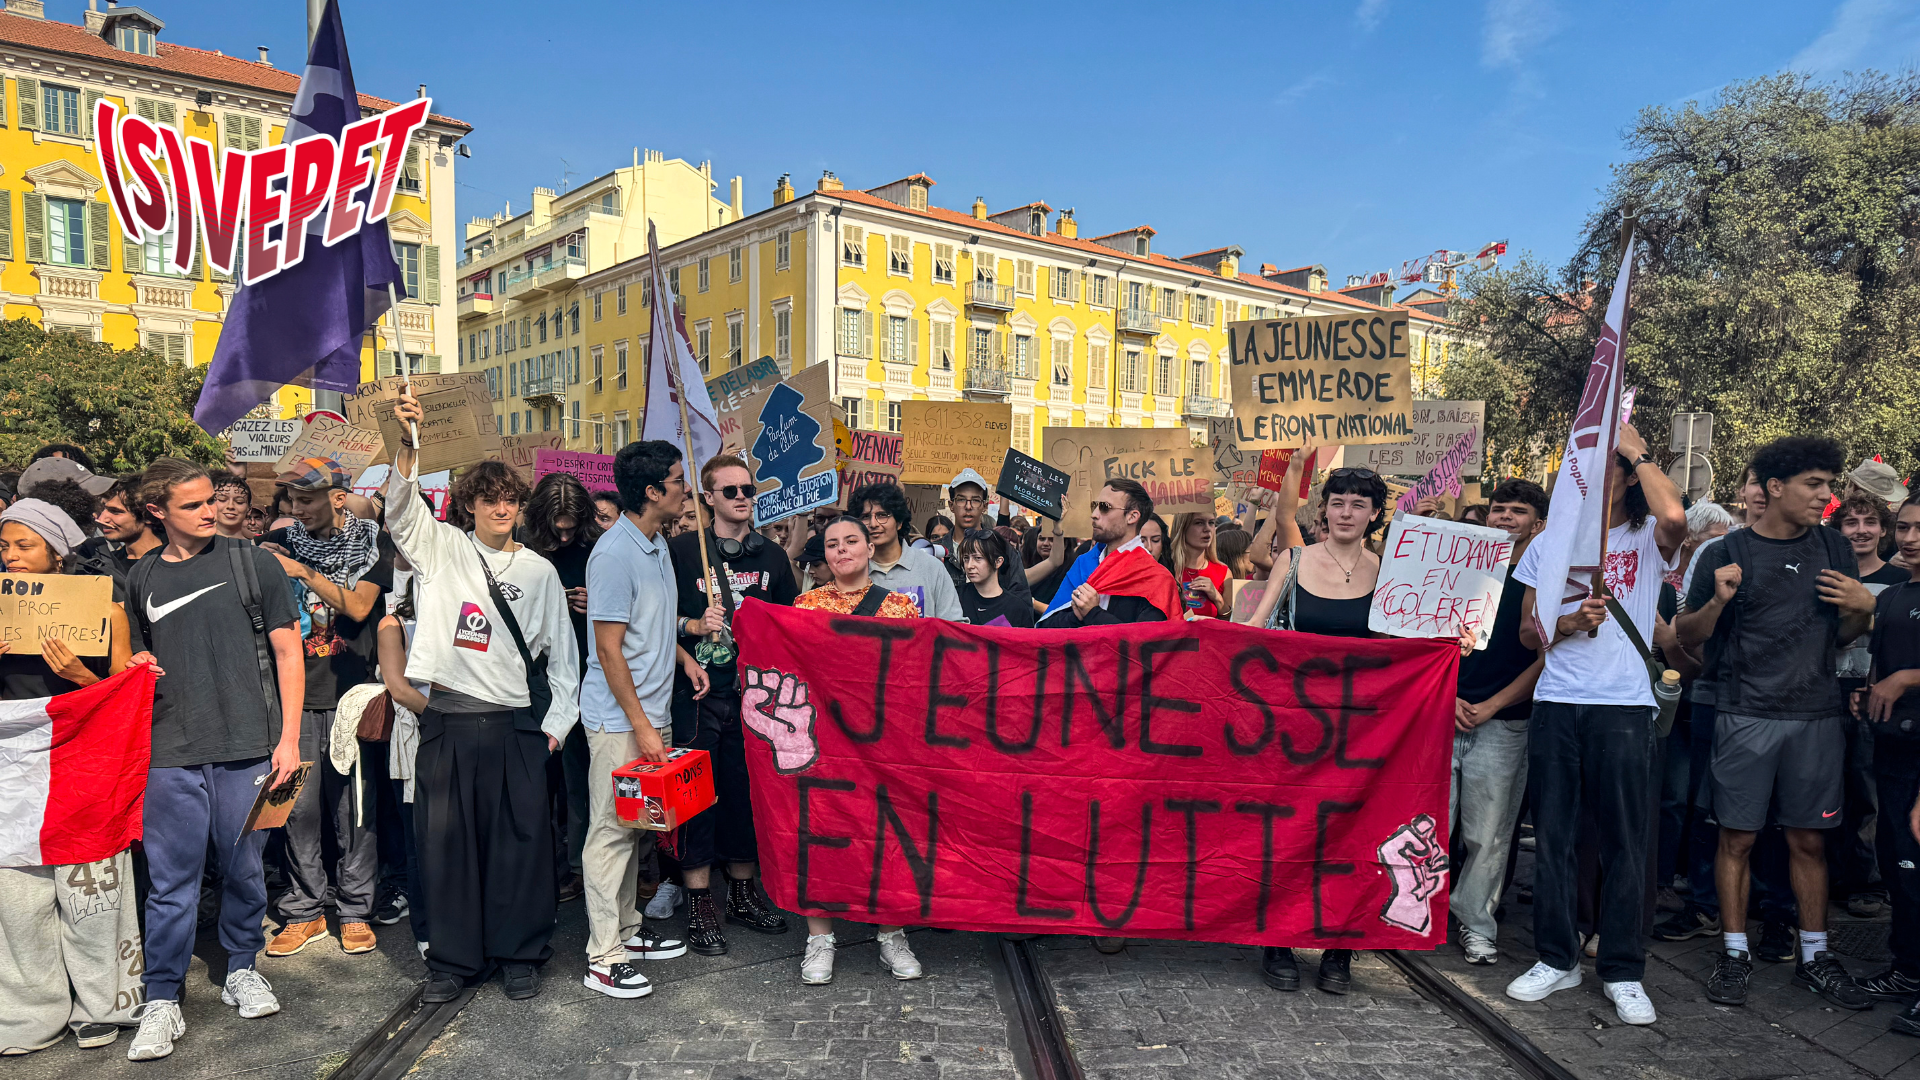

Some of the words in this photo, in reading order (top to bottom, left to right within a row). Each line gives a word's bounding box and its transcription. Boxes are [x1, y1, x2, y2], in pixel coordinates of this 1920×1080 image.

[1230, 325, 1259, 365] LA
[1263, 316, 1407, 363] JEUNESSE
[436, 376, 456, 387] LES
[460, 374, 487, 385] SIENS
[1258, 367, 1394, 404] EMMERDE
[706, 385, 717, 402] E
[233, 420, 271, 433] GAZEZ
[274, 421, 294, 433] LES
[348, 405, 367, 426] LA
[1236, 415, 1268, 442] LE
[1271, 412, 1336, 444] FRONT
[1336, 407, 1413, 439] NATIONAL
[248, 433, 291, 444] VIOLEURS
[310, 431, 336, 444] EN
[337, 439, 376, 453] RUINE
[420, 429, 463, 444] OMPLETE
[596, 461, 614, 473] CRIT
[1103, 456, 1156, 480] FUCK
[1169, 457, 1196, 477] LE
[1368, 449, 1404, 466] LES
[1014, 456, 1043, 476] GAZER
[1049, 472, 1064, 485] LES
[1259, 469, 1284, 484] M'ENCU
[1015, 474, 1028, 485] PAS
[1032, 482, 1046, 493] LES
[758, 490, 781, 509] CONTRE
[782, 484, 796, 500] UNE
[760, 496, 793, 519] NATIONALE
[793, 494, 804, 509] QUI
[806, 489, 821, 505] PUE
[1013, 484, 1054, 508] BLOQUEURS
[1394, 523, 1511, 573] ÉTUDIANTE
[1422, 568, 1461, 591] EN
[18, 600, 61, 615] PROF
[1383, 583, 1482, 626] COLÈRE
[827, 617, 1394, 768] JEUNESSE
[797, 777, 938, 918] EN
[1016, 789, 1366, 939] LUTTE
